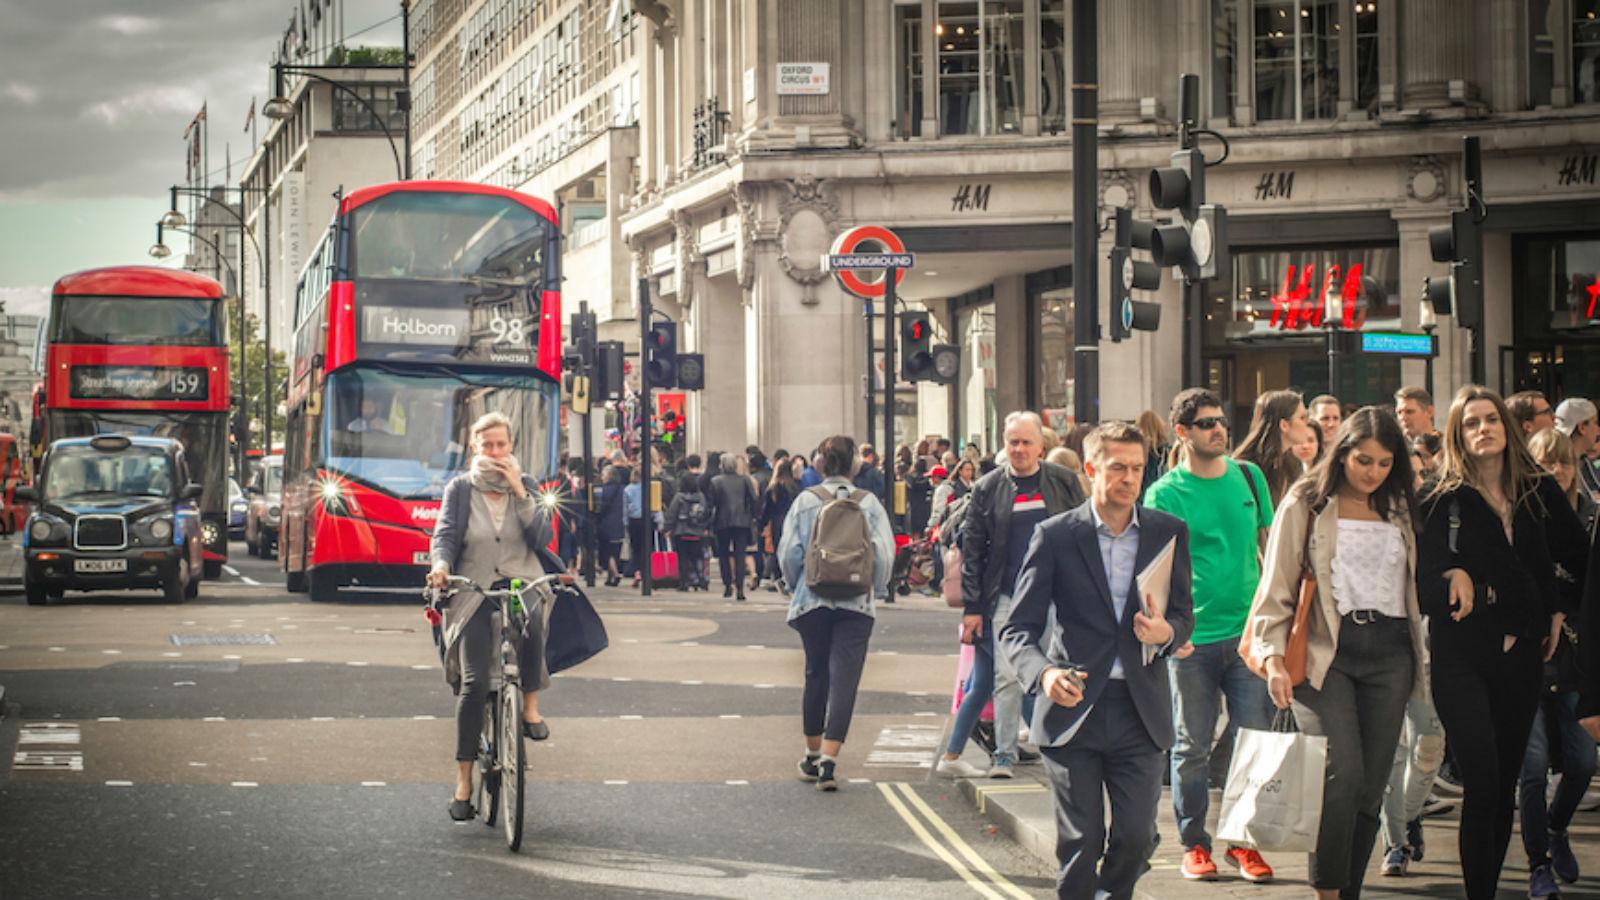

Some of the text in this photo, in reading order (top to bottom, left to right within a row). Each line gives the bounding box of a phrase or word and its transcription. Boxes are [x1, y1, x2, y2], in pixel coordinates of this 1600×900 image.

[781, 66, 814, 74] OXFORD
[781, 75, 811, 84] CIRCUS
[1255, 171, 1296, 200] H&M
[951, 184, 992, 212] H&M
[290, 180, 299, 266] JOHN LEWIS
[832, 255, 912, 266] UNDERGROUND
[382, 316, 525, 344] Holborn 98
[170, 374, 199, 393] 159
